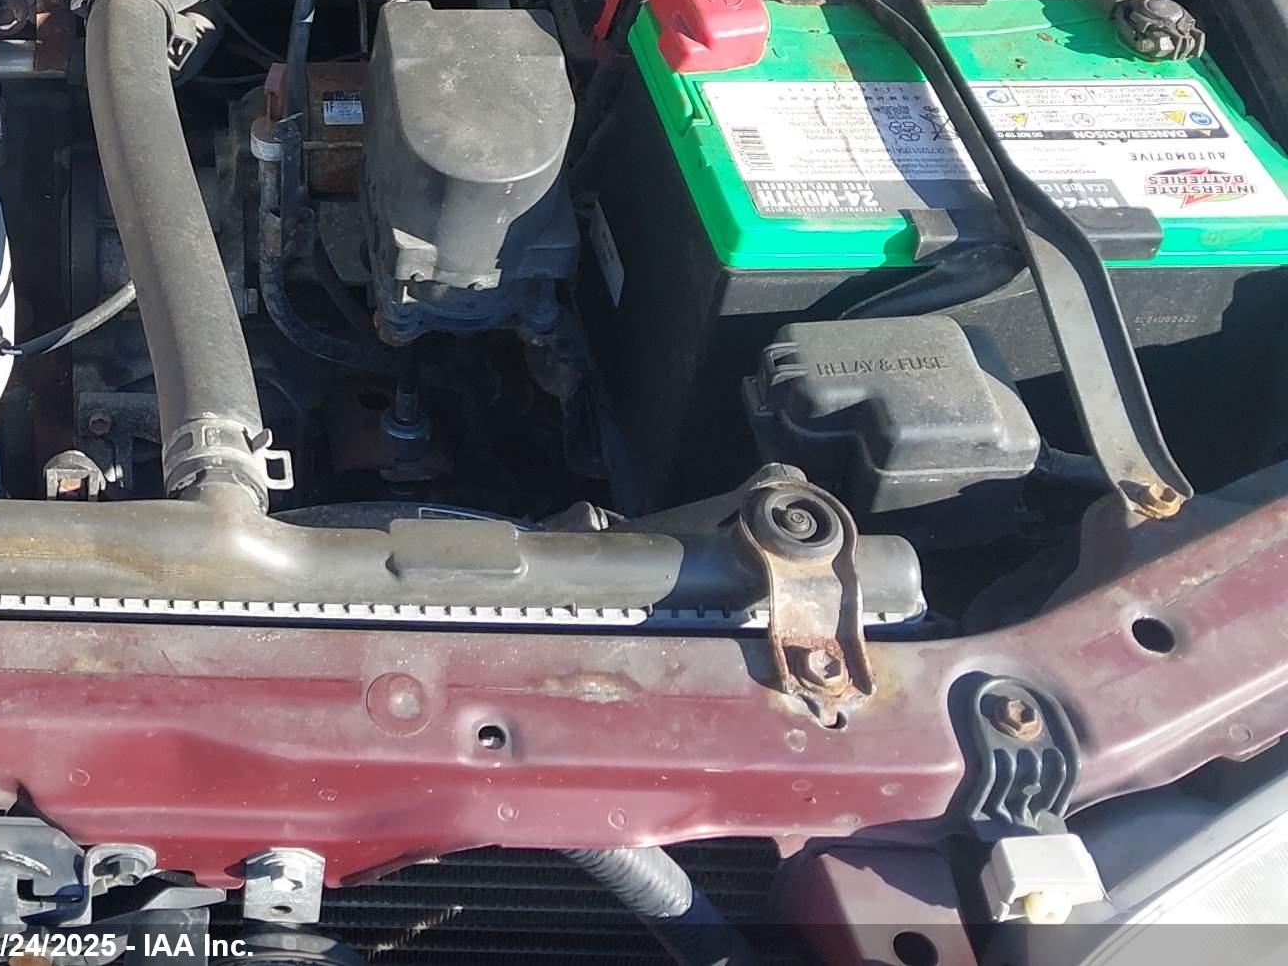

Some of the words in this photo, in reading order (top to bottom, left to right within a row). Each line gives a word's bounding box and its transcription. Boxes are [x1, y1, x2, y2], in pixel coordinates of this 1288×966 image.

[1073, 130, 1188, 139] DANGER/POISON
[1128, 151, 1226, 161] AUTOMOTIVE
[1148, 175, 1244, 185] BATTERIES
[755, 182, 838, 190] REPLACEMENT
[1146, 184, 1256, 195] INTERSTATE
[757, 190, 880, 207] 24-MONTH
[816, 359, 874, 377] RELAY
[879, 359, 893, 372] &
[896, 356, 950, 372] FUSE
